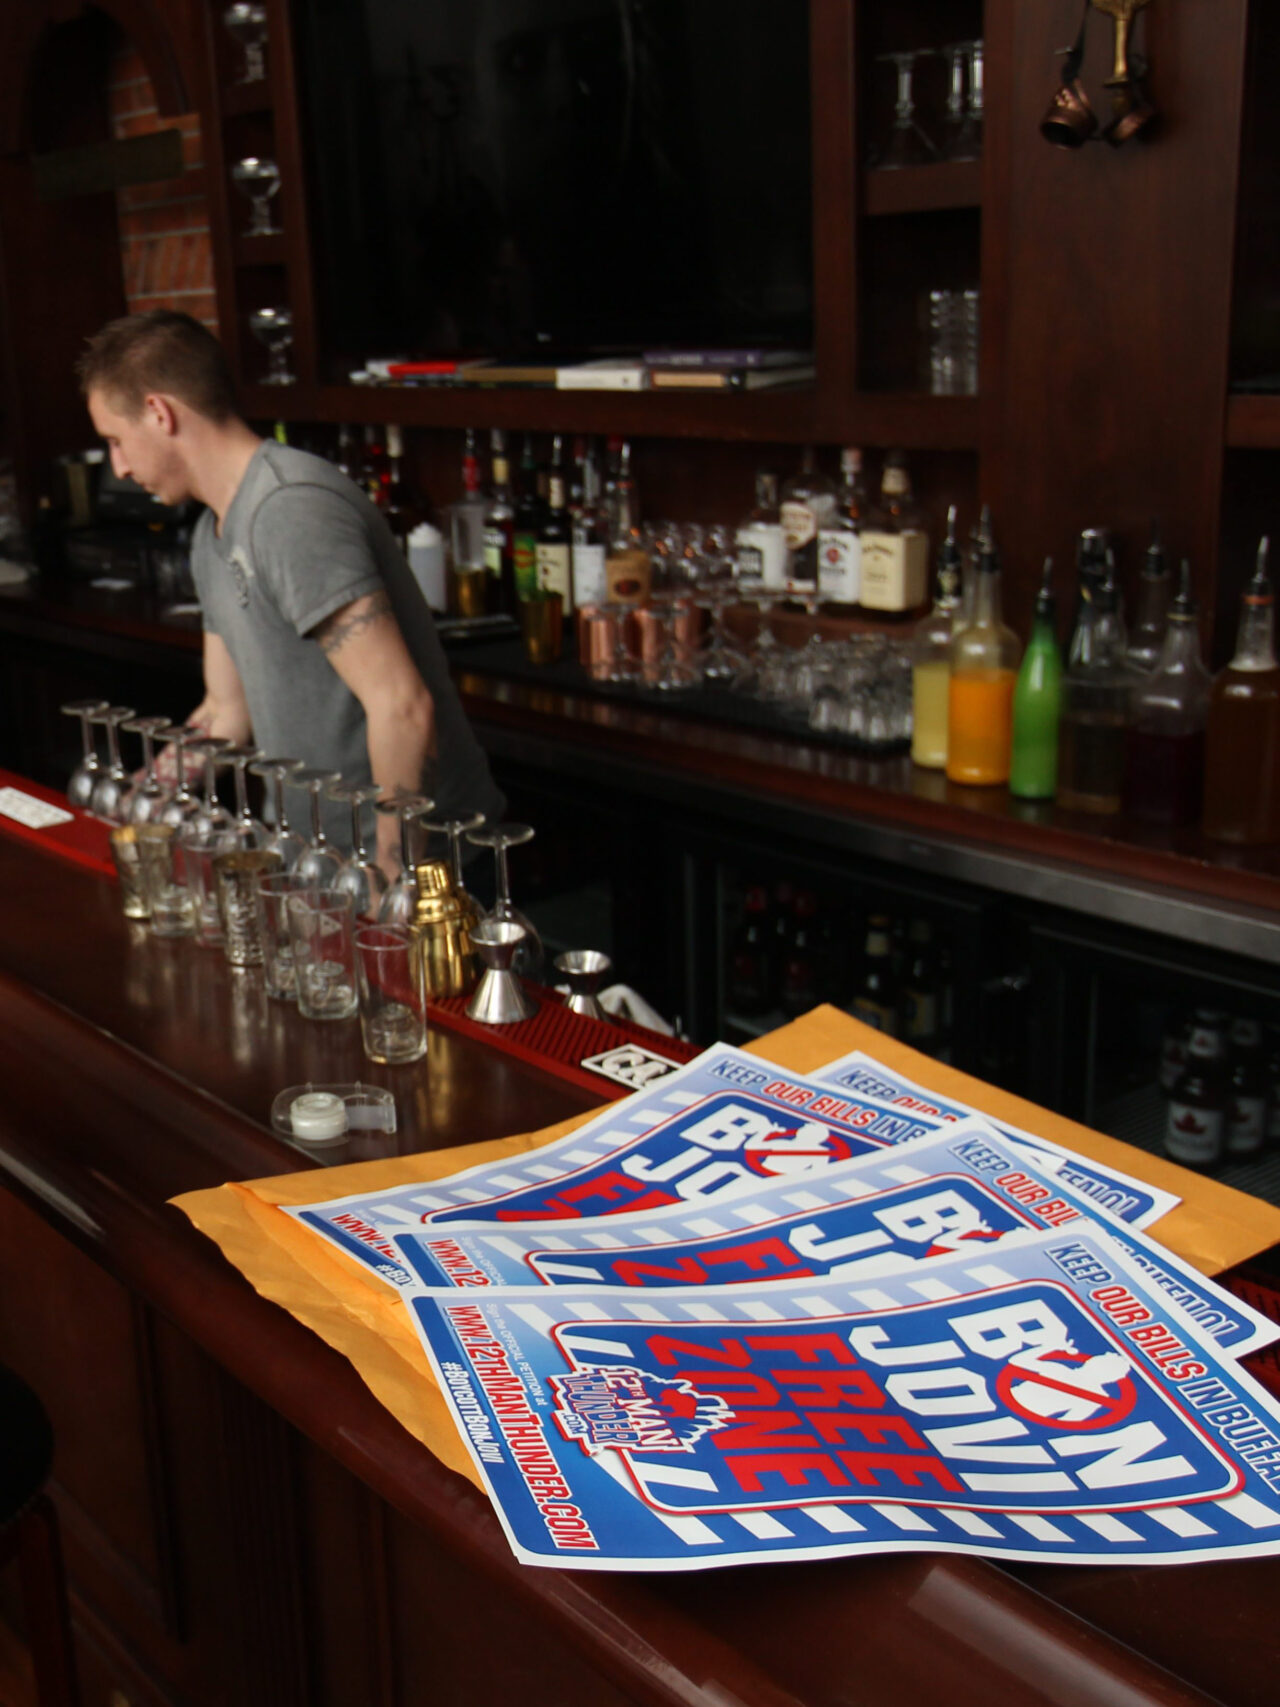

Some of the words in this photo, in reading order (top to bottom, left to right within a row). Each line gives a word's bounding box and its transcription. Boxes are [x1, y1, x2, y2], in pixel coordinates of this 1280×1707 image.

[710, 1060, 767, 1088] KEEP
[762, 1080, 815, 1106] OUR
[808, 1095, 878, 1128] BILLS
[869, 1115, 908, 1140] IN
[836, 1069, 896, 1101] KEEP
[948, 1137, 1012, 1175] KEEP
[993, 1171, 1054, 1206] OUR
[1032, 1197, 1084, 1228] BIL
[1046, 1242, 1114, 1288] KEEP
[1088, 1285, 1154, 1328] OUR
[1123, 1322, 1208, 1382] BILLS
[1178, 1376, 1238, 1410] IN
[518, 1361, 545, 1396] PETITION
[564, 1375, 640, 1442] THUNDER
[645, 1334, 852, 1493] ZONE
[743, 1333, 966, 1493] FREE
[848, 1325, 1079, 1493] JOVI
[617, 1398, 683, 1446] MAN
